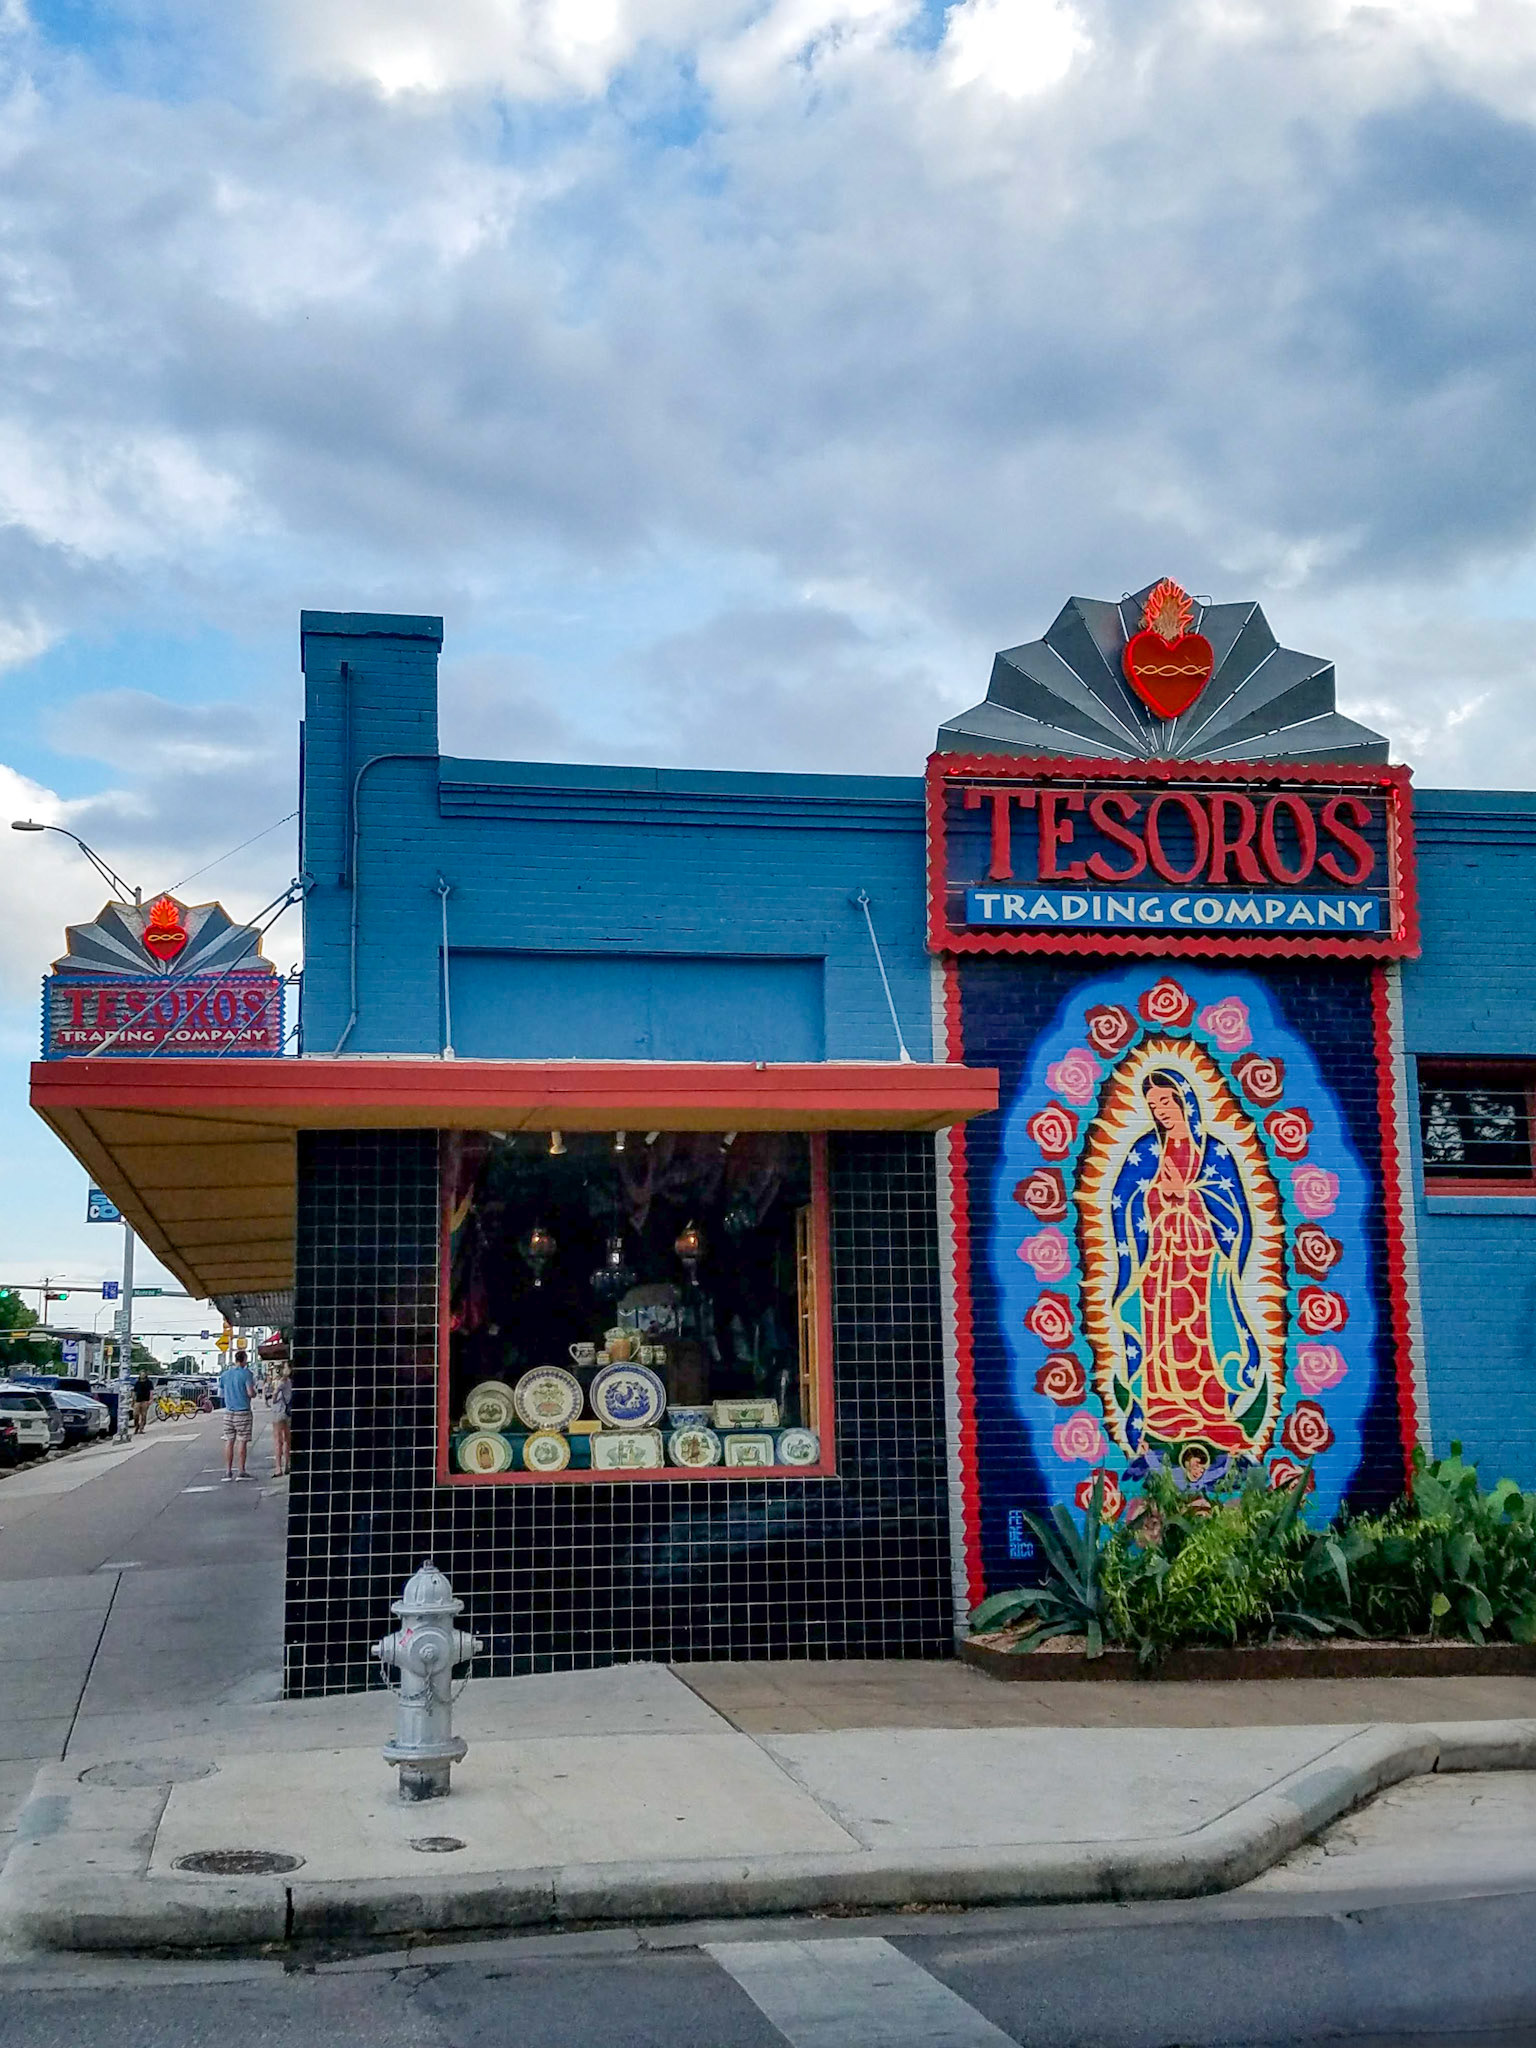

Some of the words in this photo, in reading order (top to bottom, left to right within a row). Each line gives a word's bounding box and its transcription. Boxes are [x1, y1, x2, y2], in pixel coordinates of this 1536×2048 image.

[964, 788, 1375, 886] TESOROS
[974, 892, 1164, 924] TRADING
[1170, 896, 1373, 926] COMPANY
[63, 989, 267, 1027] TESOROS
[61, 1030, 155, 1043] TRADING
[164, 1029, 266, 1042] COMPANY
